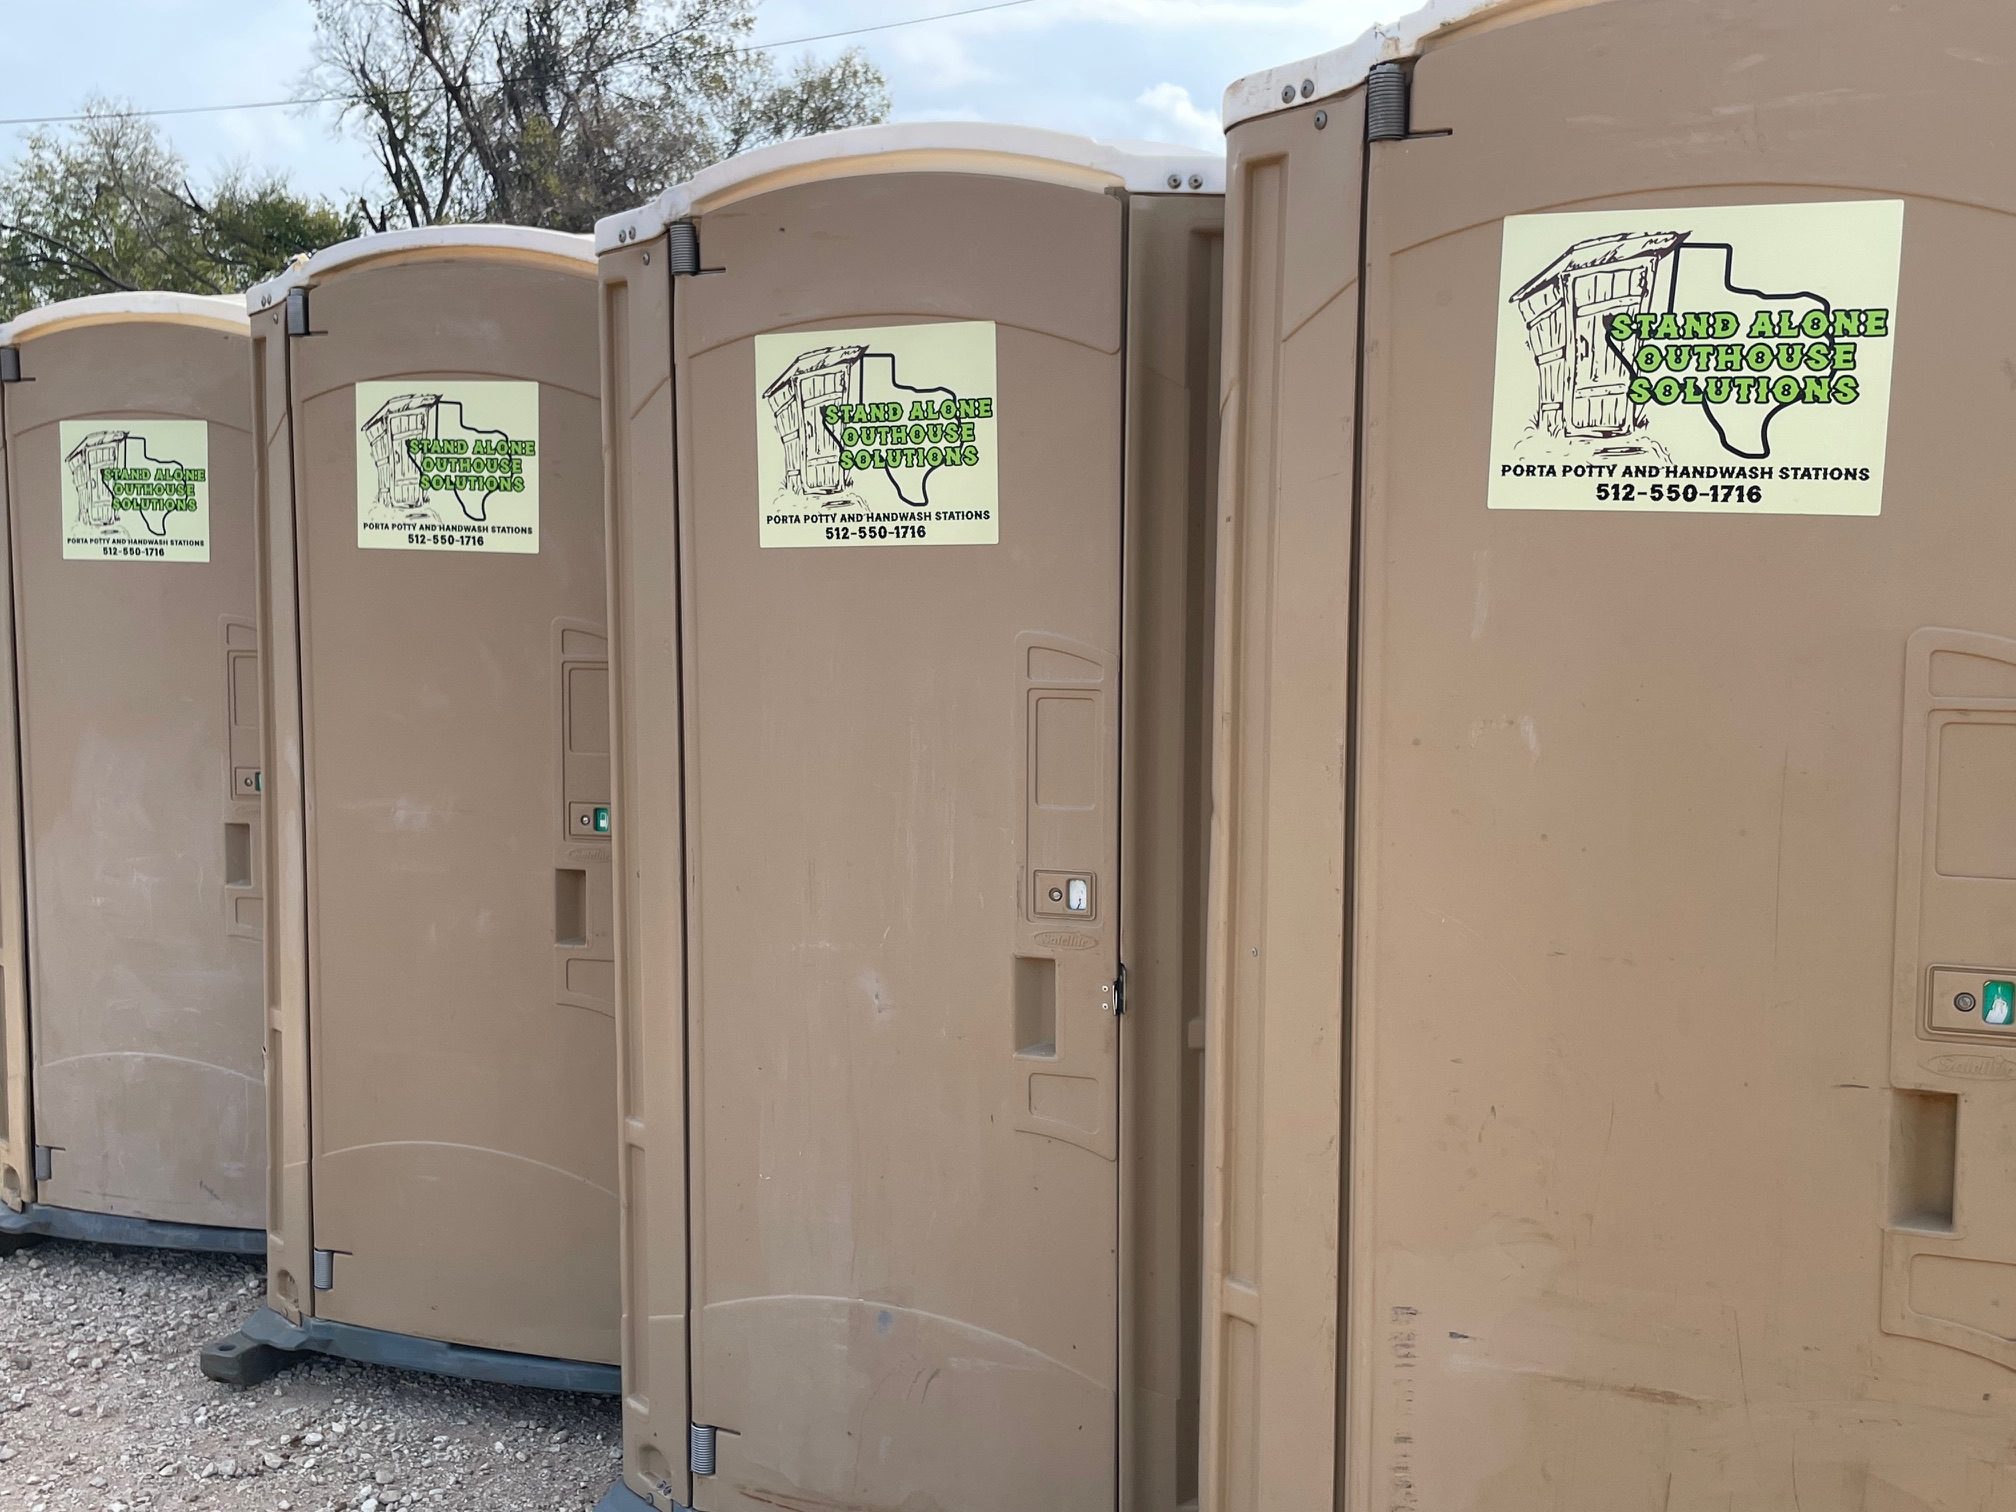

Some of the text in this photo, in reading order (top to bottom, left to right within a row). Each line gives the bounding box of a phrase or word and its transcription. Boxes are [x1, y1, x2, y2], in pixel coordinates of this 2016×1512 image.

[1610, 309, 1889, 341] STAND ALONE
[1635, 342, 1857, 372] OUTHOUSE
[1628, 375, 1859, 405] SOLUTIONS
[825, 398, 993, 425] STAND ALONE
[841, 422, 976, 447] OUTHOUSE
[409, 439, 536, 456] STAND ALONE
[422, 457, 522, 473] OUTHOUSE
[839, 446, 979, 470] SOLUTIONS
[103, 468, 206, 481] STAND ALONE
[1501, 465, 1870, 481] PORTA POTTY AND HANDWASH STATIONS
[113, 484, 195, 496] OUTHOUSE
[419, 474, 525, 492] SOLUTIONS
[1596, 484, 1762, 503] 512-550-1716
[112, 498, 197, 511] SOLUTIONS
[767, 510, 990, 524] PORTA POTTY AND HANDWASH STATIONS
[363, 522, 389, 530] PORTA
[391, 523, 417, 531] POTTY
[439, 524, 488, 533] HANDWASH
[491, 525, 532, 534] STATIONS
[826, 525, 926, 539] 512-550-1716
[408, 534, 484, 546] 512-550-1716
[103, 547, 164, 556] 512-550-1716
